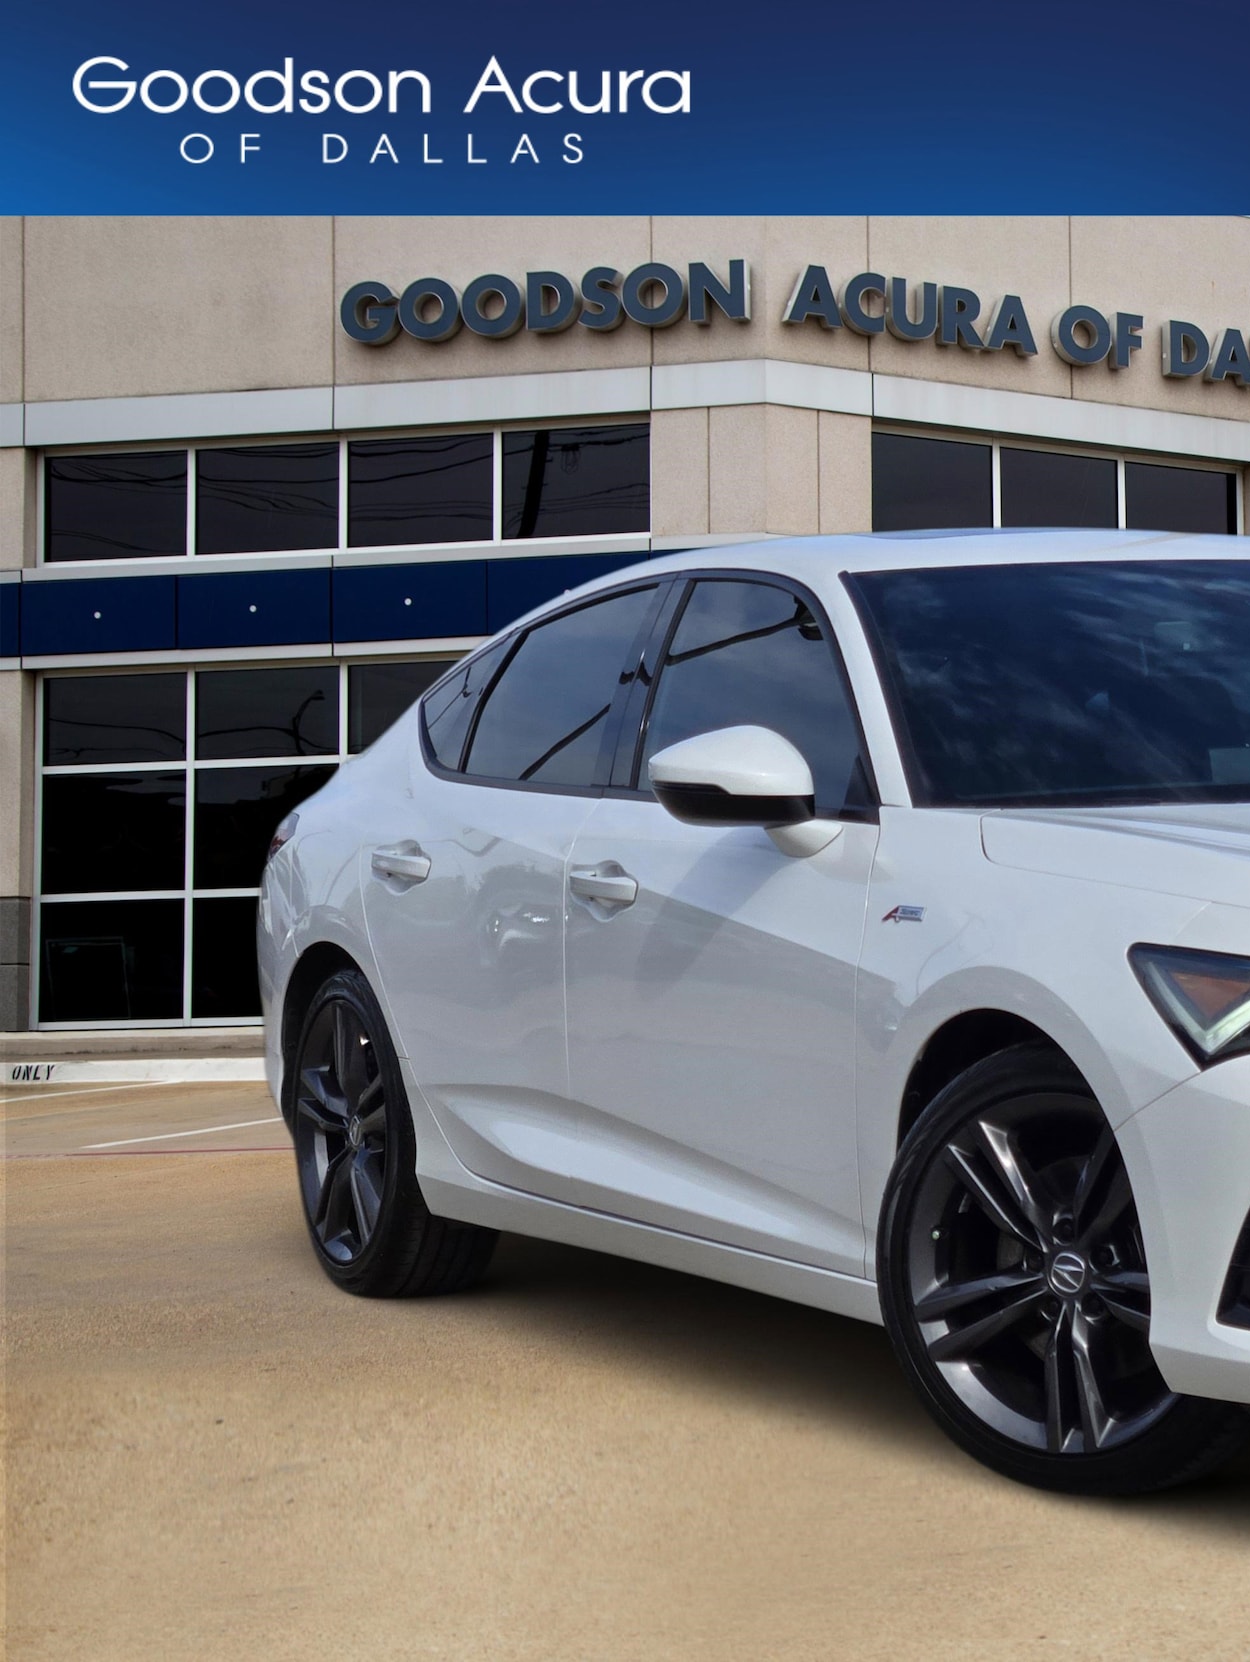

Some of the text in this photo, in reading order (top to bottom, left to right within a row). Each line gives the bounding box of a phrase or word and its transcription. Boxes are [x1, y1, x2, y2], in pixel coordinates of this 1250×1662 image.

[340, 258, 751, 346] GOODSON
[782, 264, 1038, 358] ACURA
[1051, 304, 1143, 370] OF
[11, 1064, 55, 1081] ONLY
